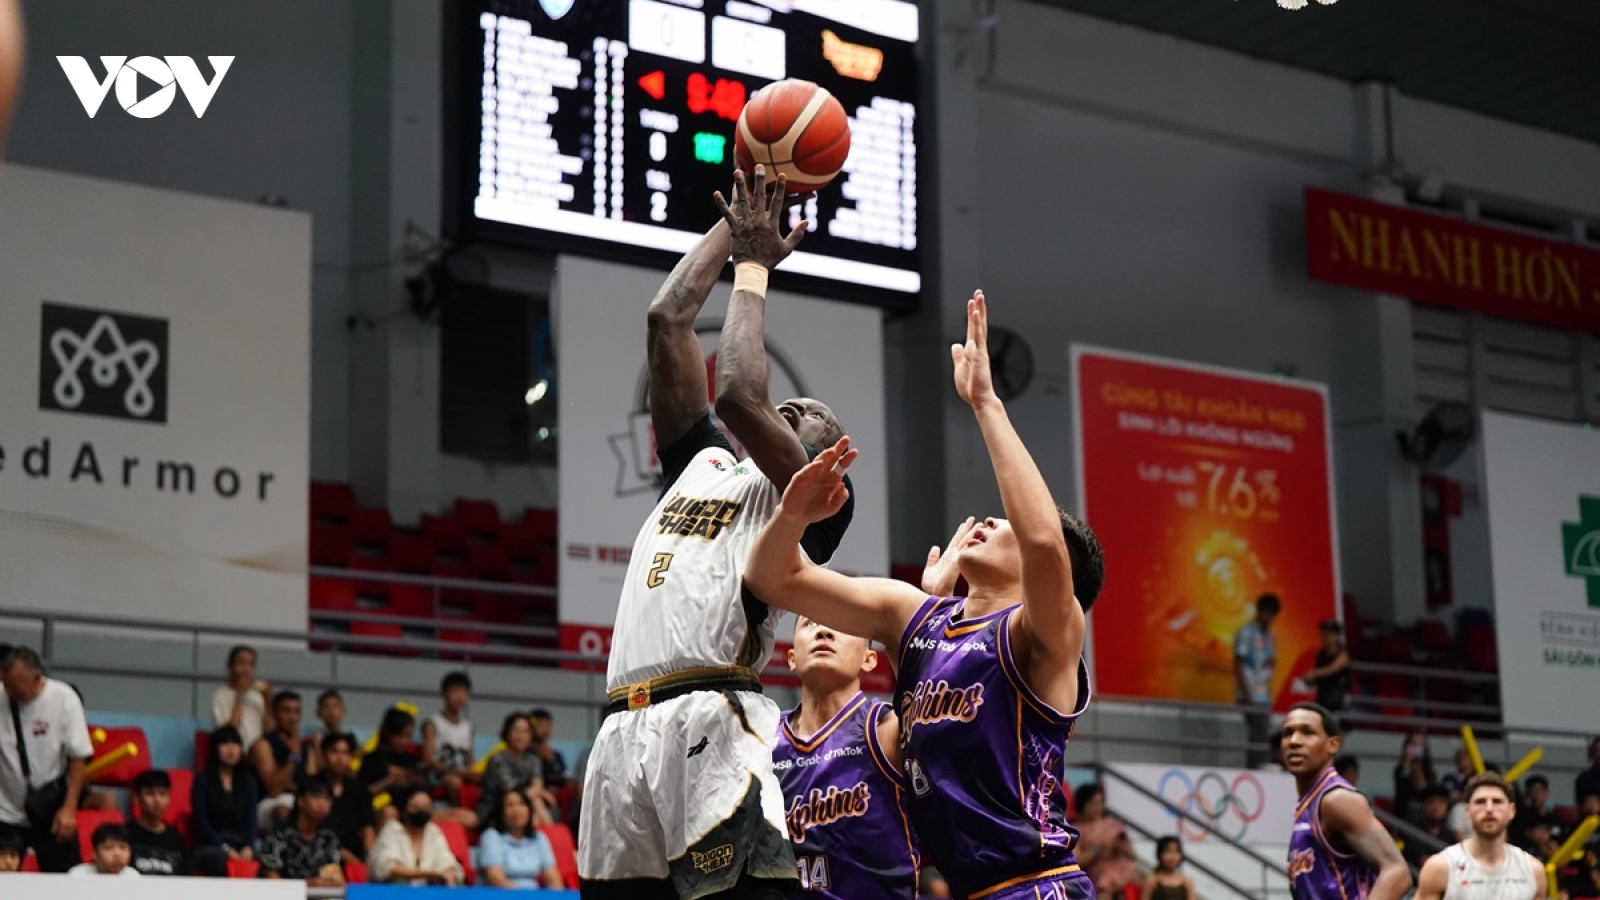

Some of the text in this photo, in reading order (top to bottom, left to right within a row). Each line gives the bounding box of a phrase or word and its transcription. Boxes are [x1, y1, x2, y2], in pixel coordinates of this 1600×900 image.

[651, 192, 667, 221] 2
[1327, 207, 1581, 309] NHANH HƠN
[0, 436, 274, 502] dArmor
[647, 552, 674, 588] 2
[772, 759, 793, 771] MSB
[832, 746, 863, 759] TikTok
[796, 856, 830, 890] 14
